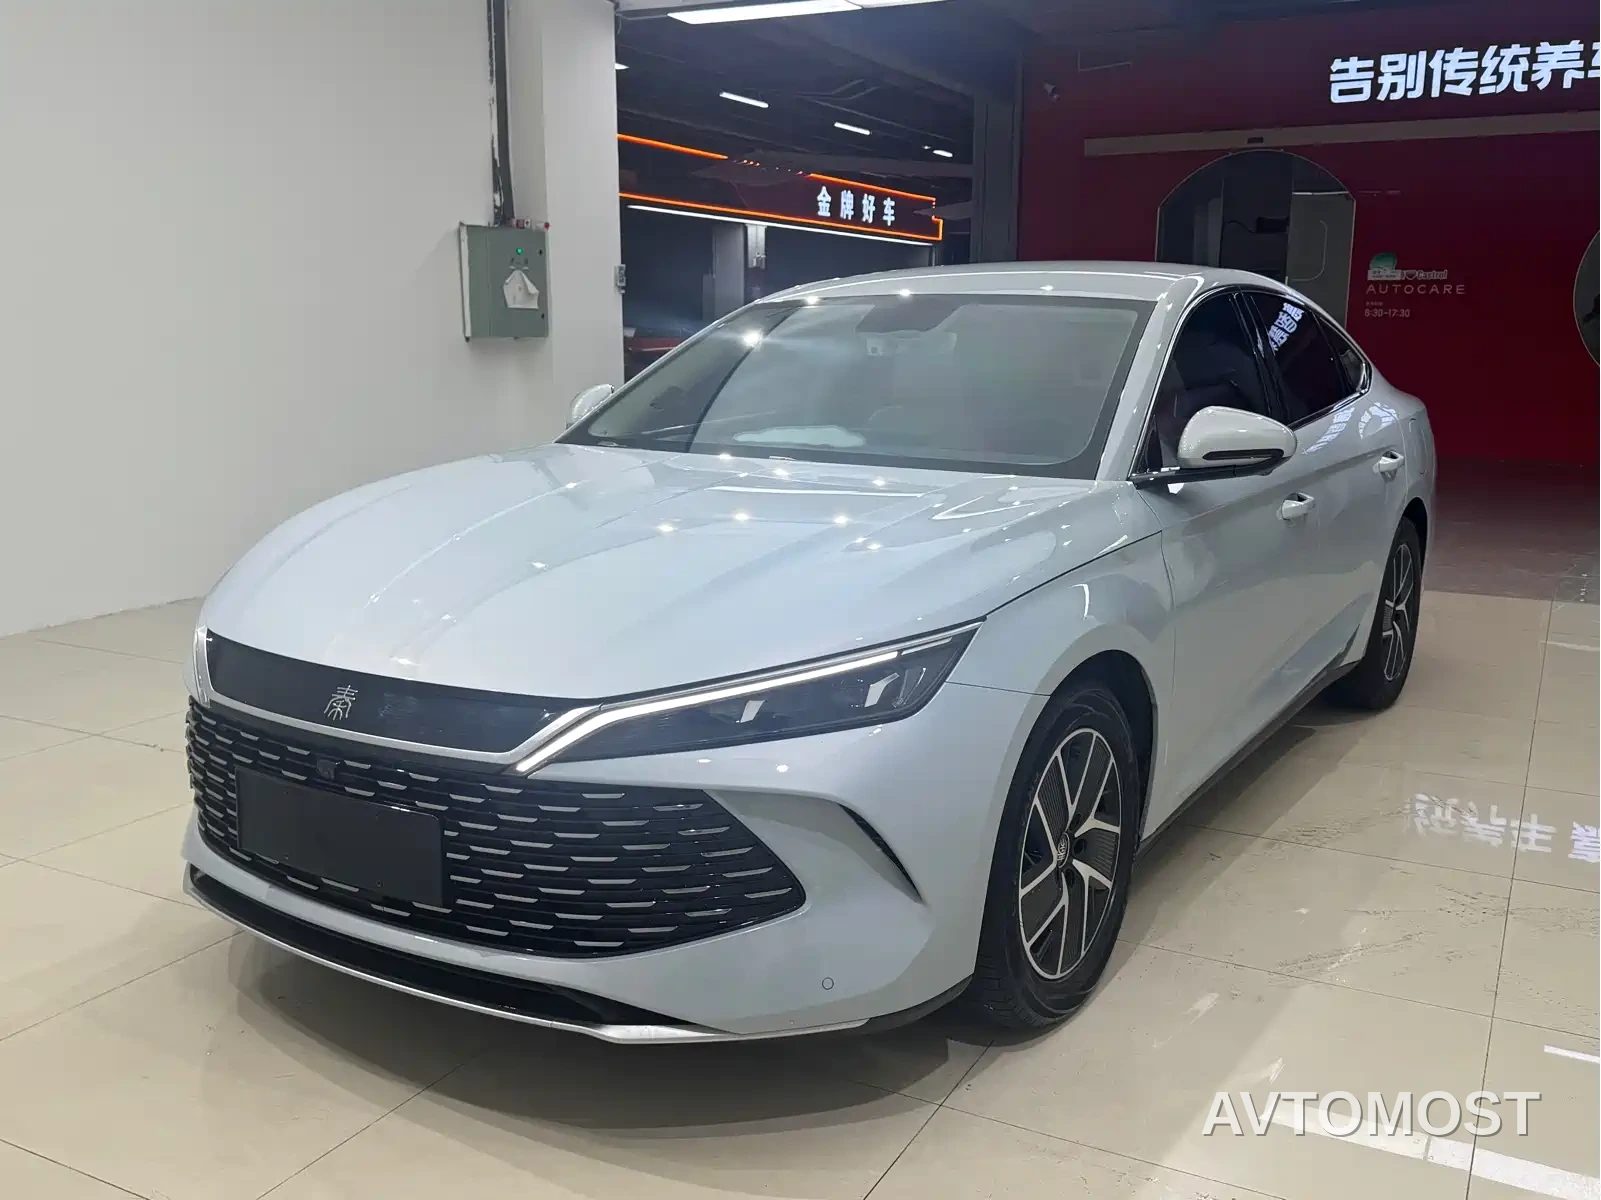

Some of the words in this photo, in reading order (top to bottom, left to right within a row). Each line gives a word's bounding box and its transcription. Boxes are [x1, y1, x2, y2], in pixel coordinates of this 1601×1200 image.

[1329, 40, 1601, 104] 告别传统养
[817, 185, 896, 226] 金牌好车
[1417, 268, 1448, 280] Castrol
[1365, 284, 1467, 295] AUTOCARE
[1364, 308, 1411, 318] 8:30-17:30
